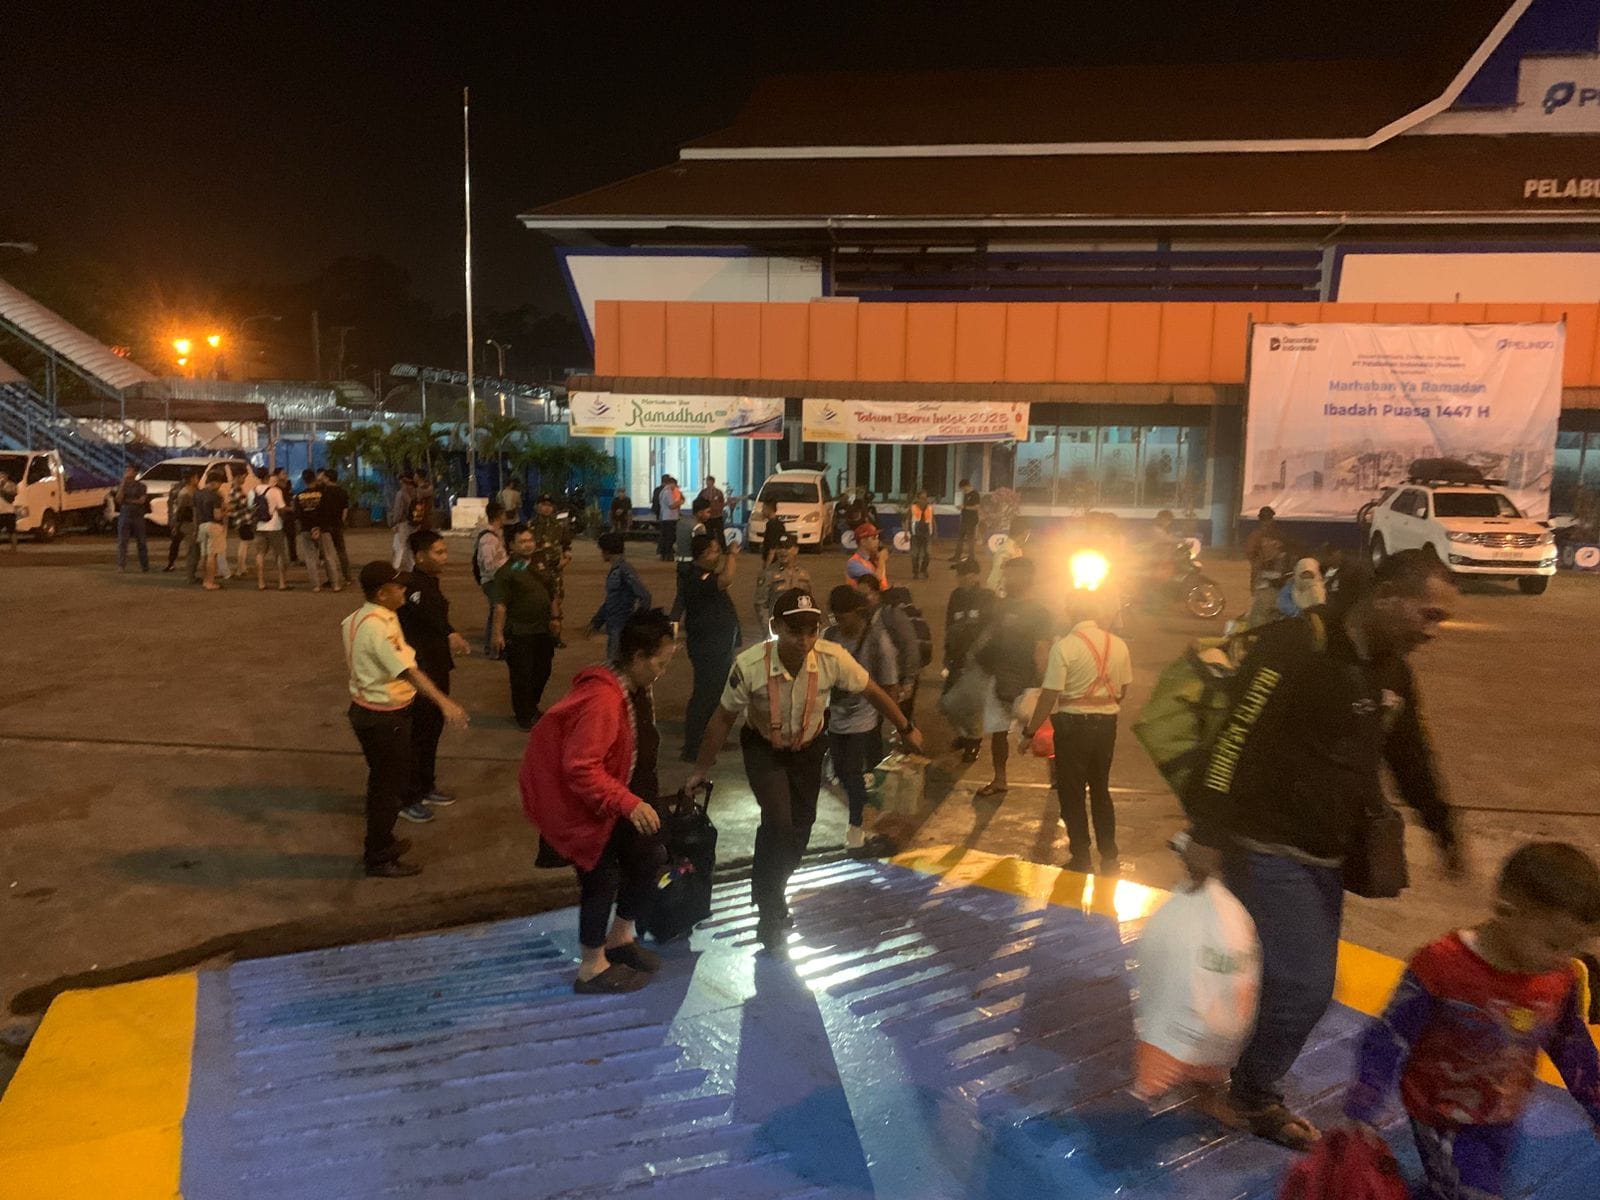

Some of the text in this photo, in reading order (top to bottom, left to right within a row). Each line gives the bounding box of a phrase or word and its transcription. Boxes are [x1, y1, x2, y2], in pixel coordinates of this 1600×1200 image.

[1329, 381, 1487, 394] Marhaban Ya Ramadan
[625, 399, 716, 427] Ramadhan
[854, 411, 892, 423] Tahun
[895, 411, 930, 424] Baru
[1323, 404, 1490, 418] Ibadah Puasa 1447 H
